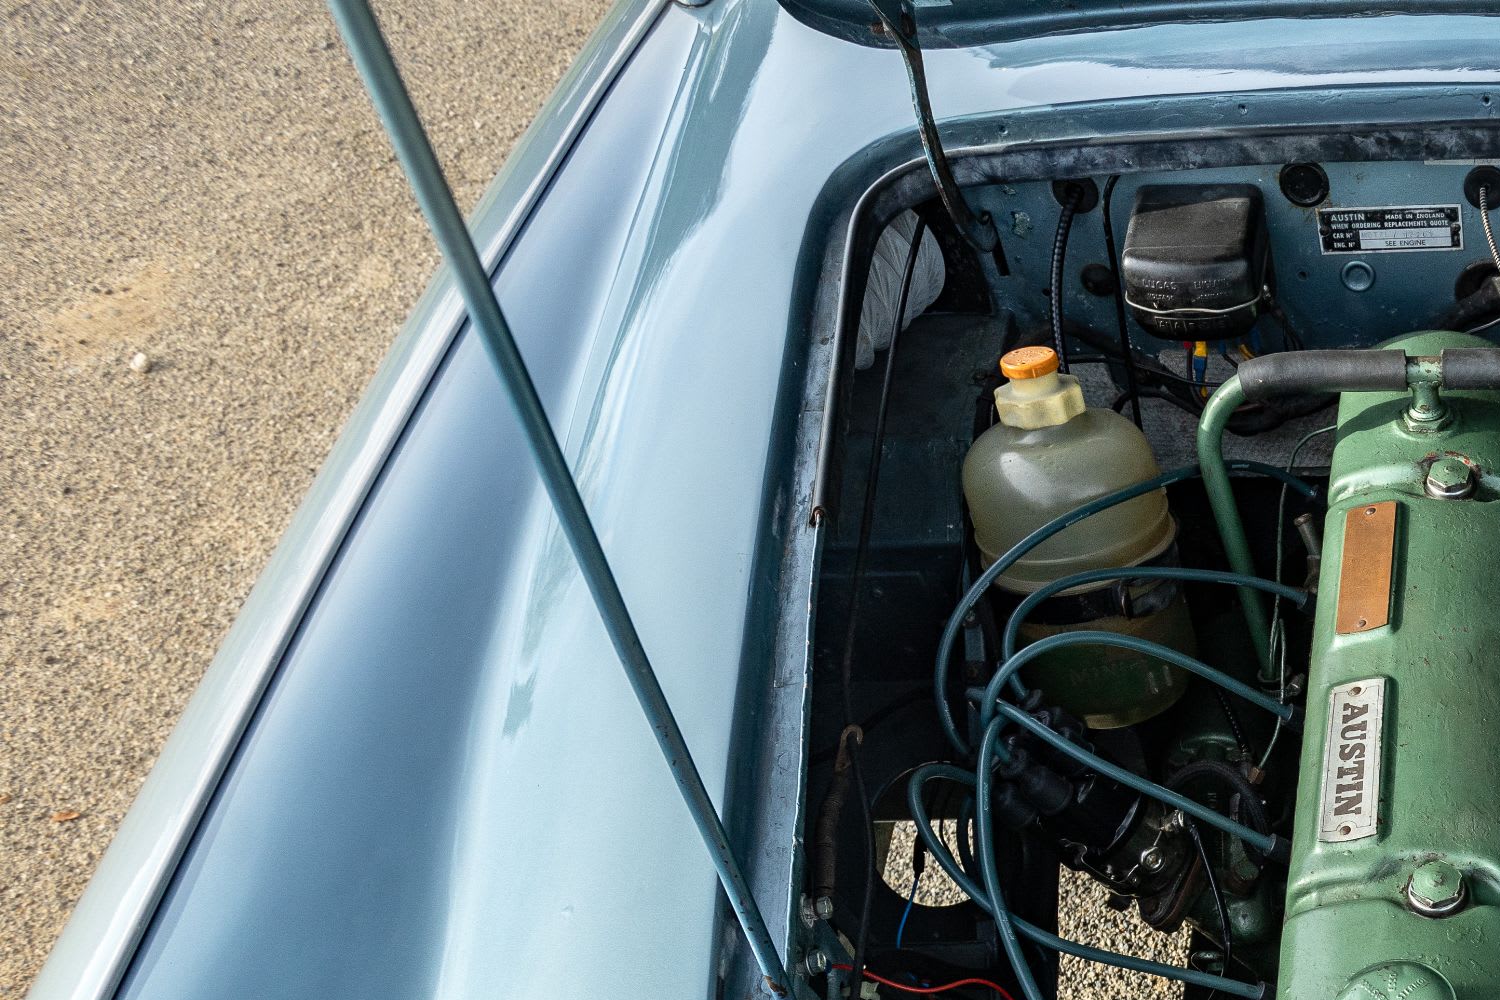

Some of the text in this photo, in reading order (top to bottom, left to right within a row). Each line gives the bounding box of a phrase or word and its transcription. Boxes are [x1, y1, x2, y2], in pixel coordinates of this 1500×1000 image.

[1331, 213, 1365, 222] AUSTIN
[1384, 220, 1427, 228] REPLACEMENTS
[1400, 239, 1426, 247] ENGINE
[1333, 703, 1369, 817] AUSTIN
